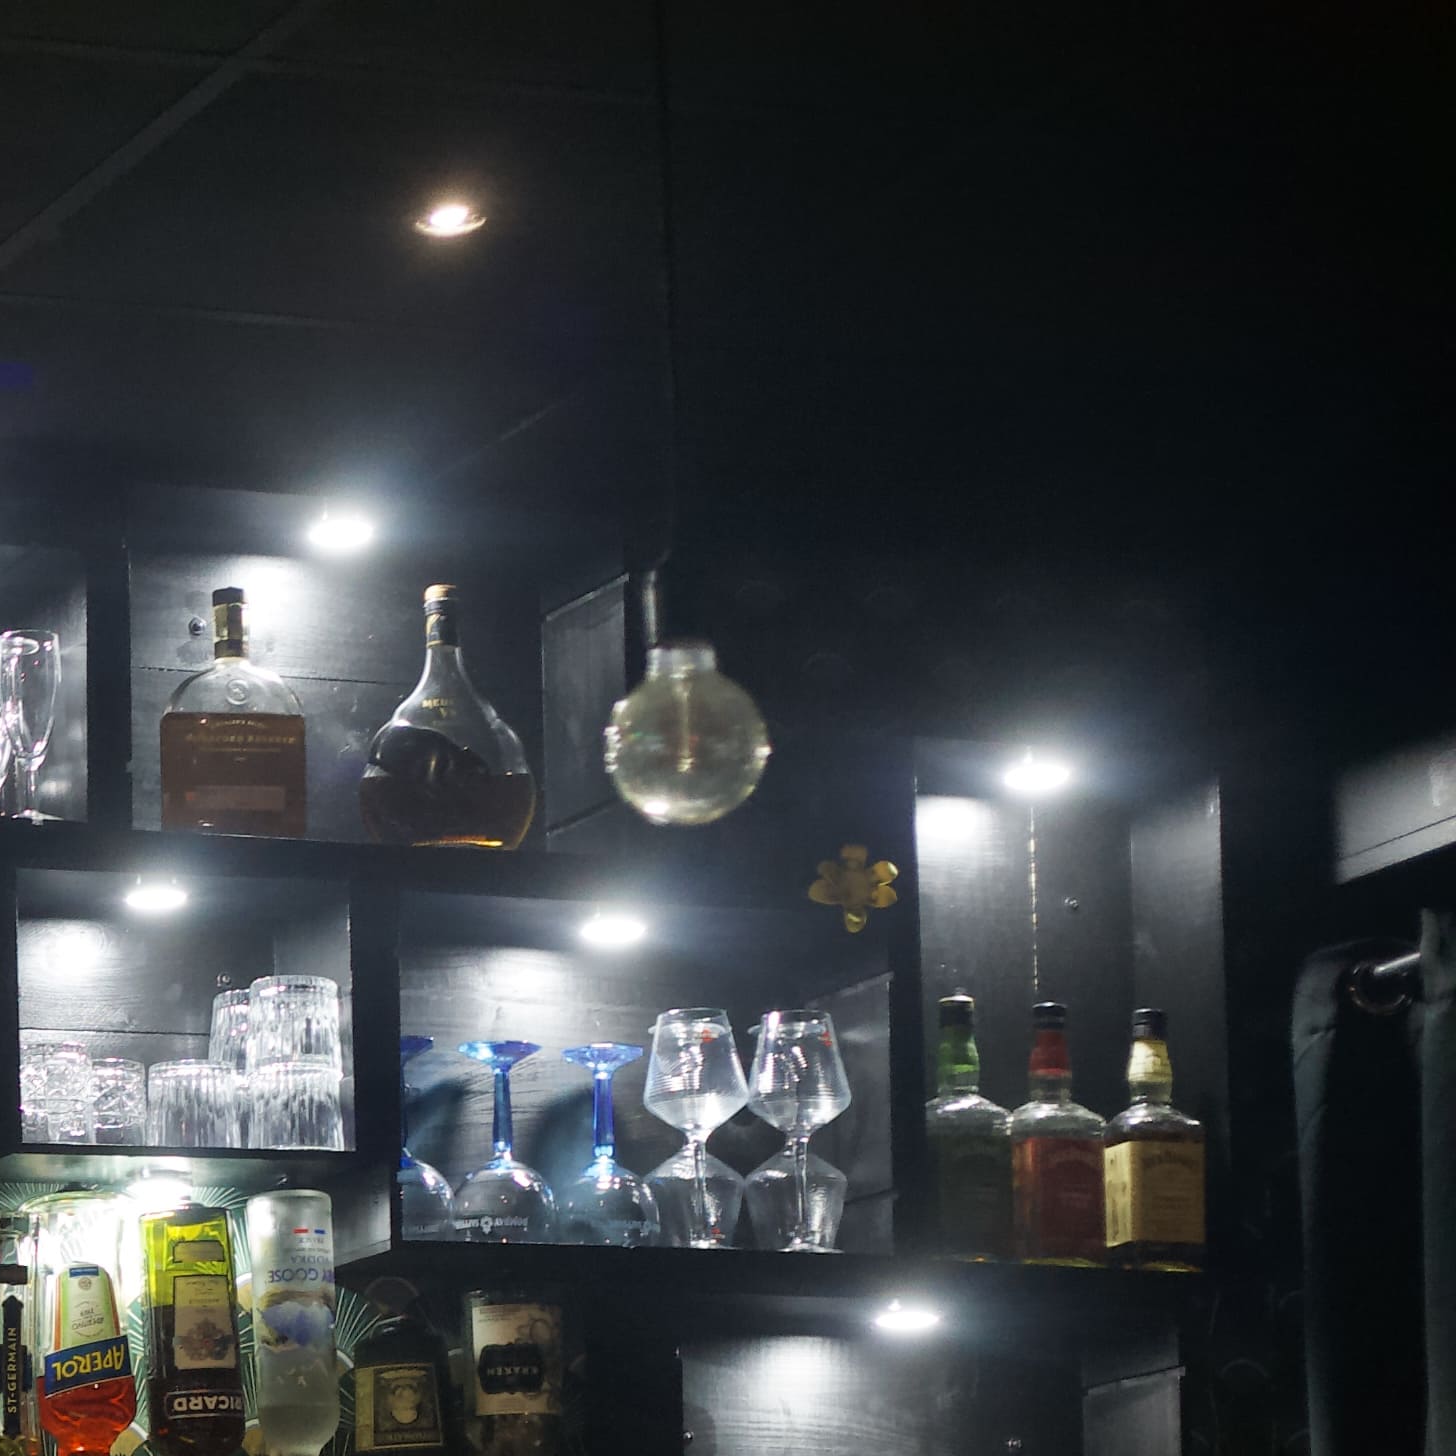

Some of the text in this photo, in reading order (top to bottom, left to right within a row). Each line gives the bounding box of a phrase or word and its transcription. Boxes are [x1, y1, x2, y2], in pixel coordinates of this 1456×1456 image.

[269, 1268, 319, 1285] GOOSE
[7, 1326, 17, 1414] ST-GERMAIN
[52, 1343, 126, 1382] APEROL
